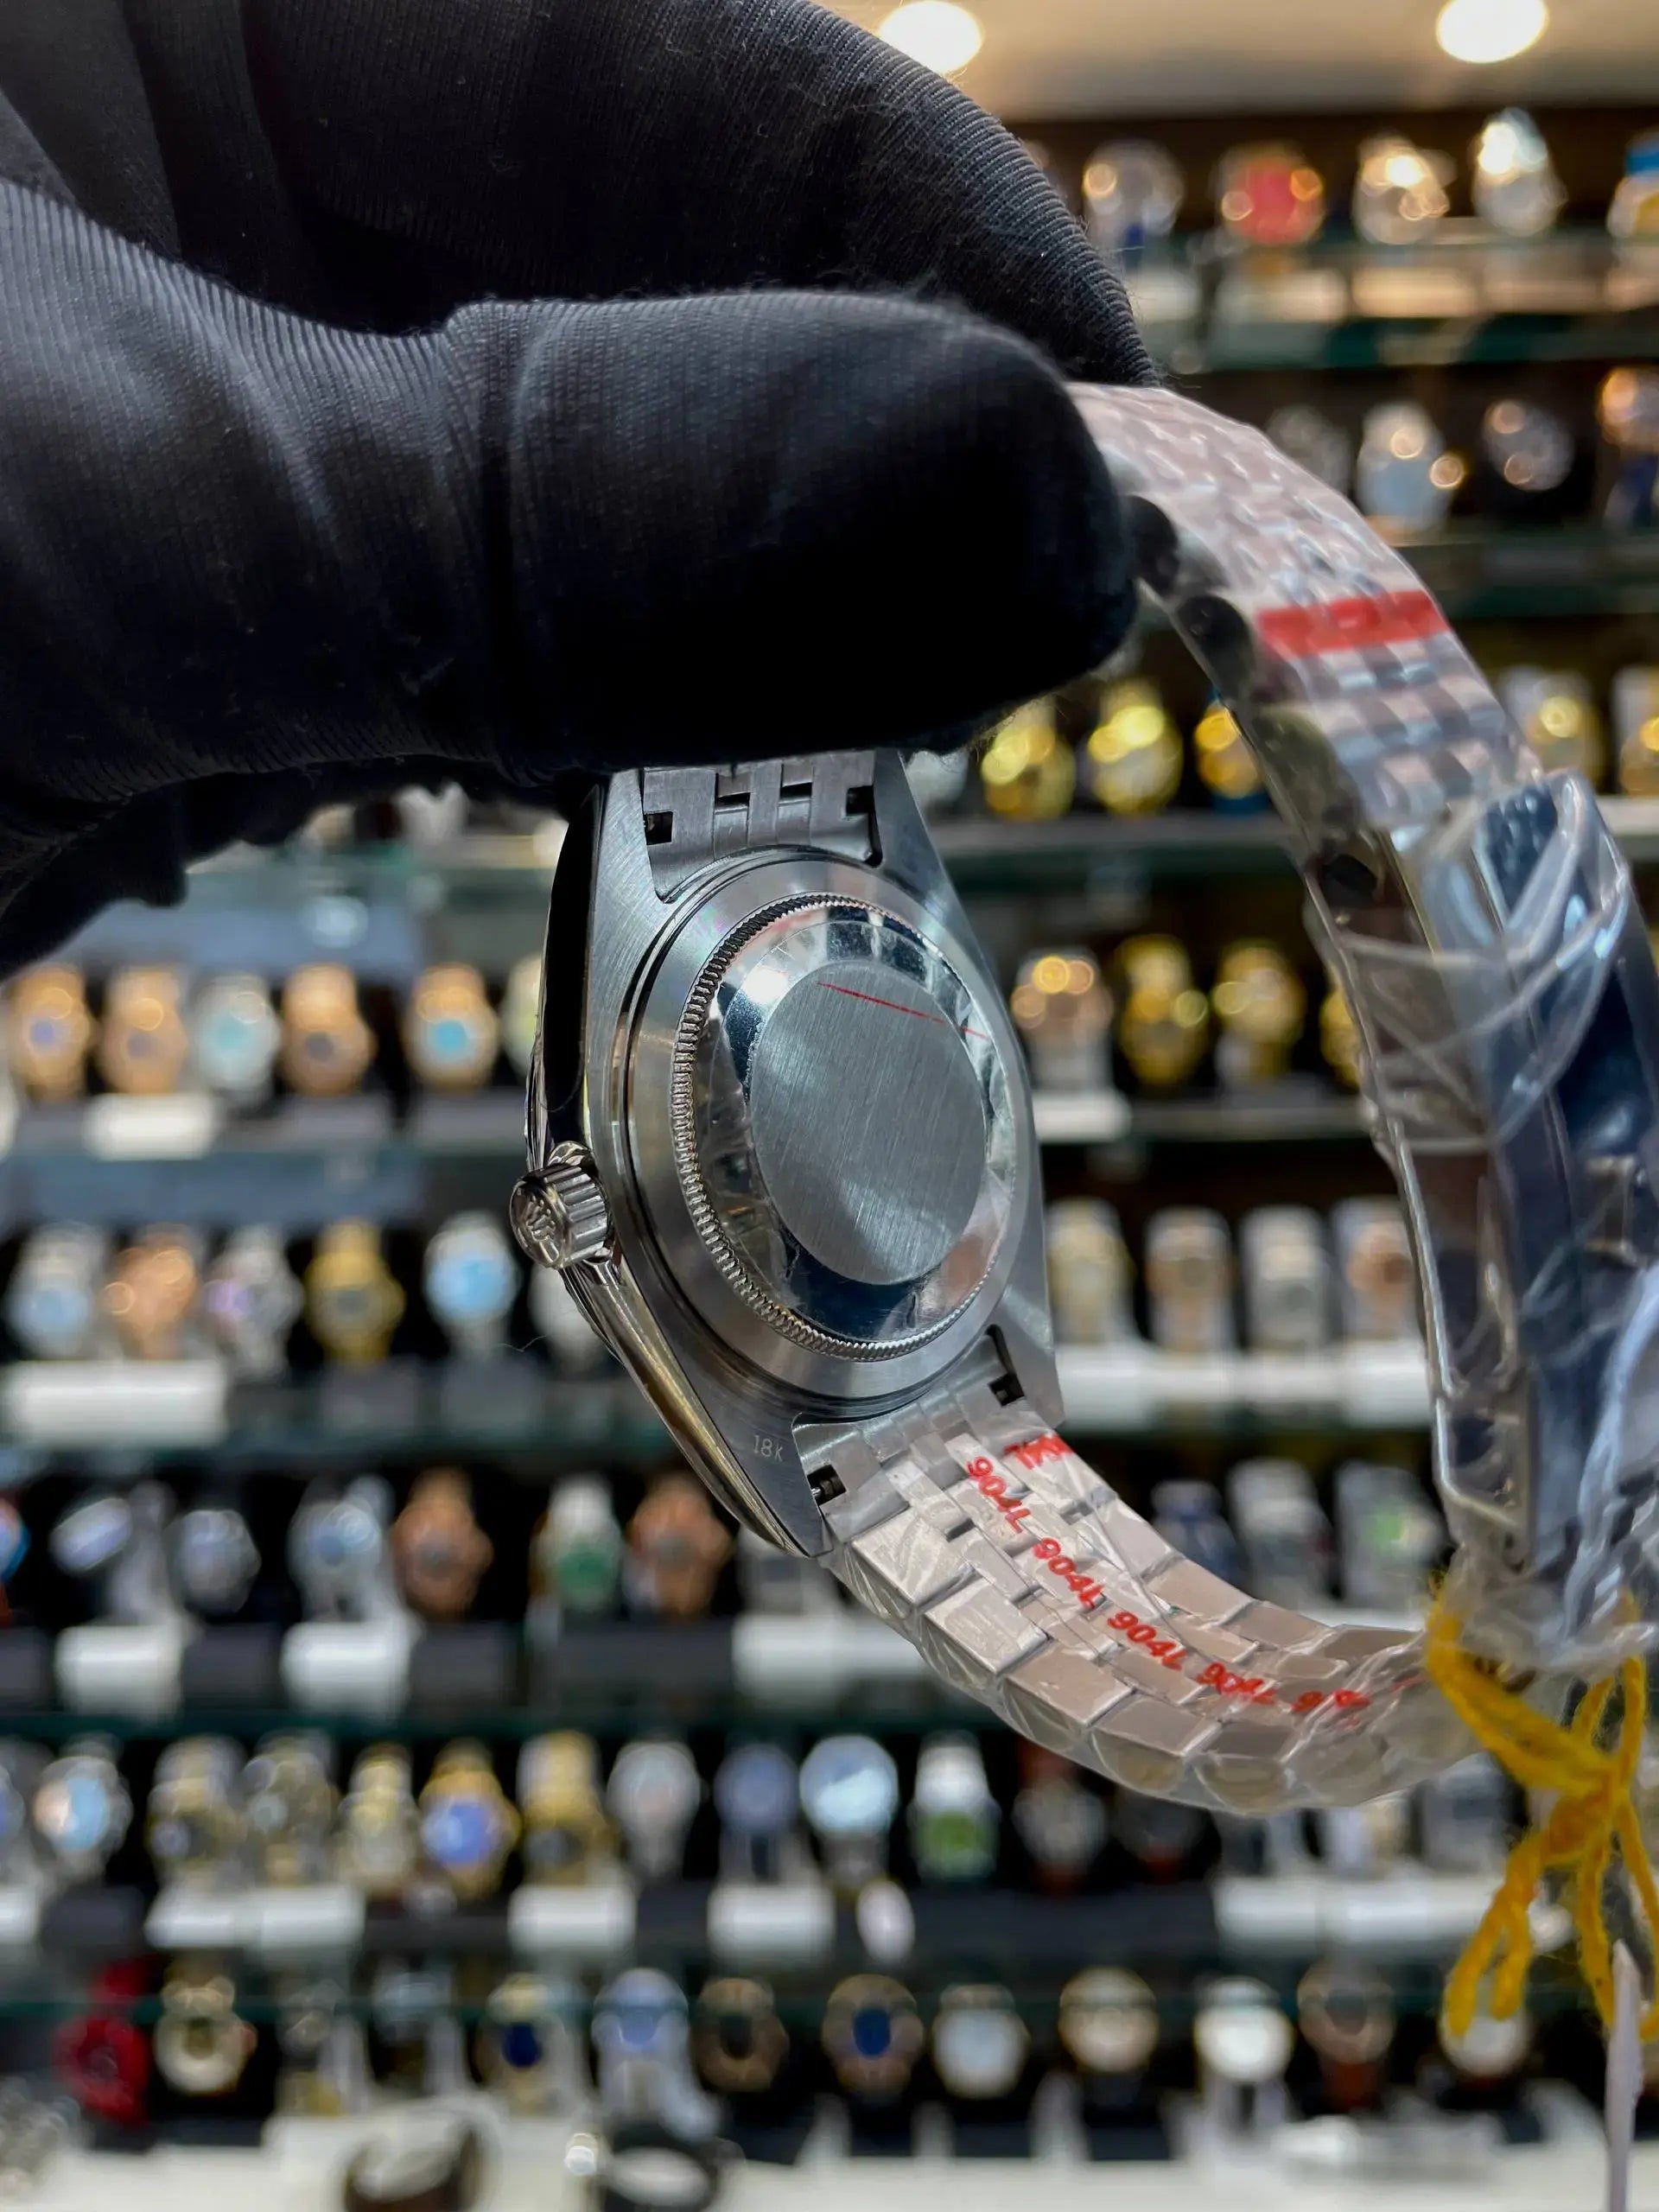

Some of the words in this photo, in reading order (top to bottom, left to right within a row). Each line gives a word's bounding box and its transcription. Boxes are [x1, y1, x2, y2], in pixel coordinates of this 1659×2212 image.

[753, 1434, 783, 1462] 18K
[967, 1456, 1031, 1534] 904L
[1033, 1537, 1104, 1610] 904L
[1106, 1611, 1187, 1672] 904L
